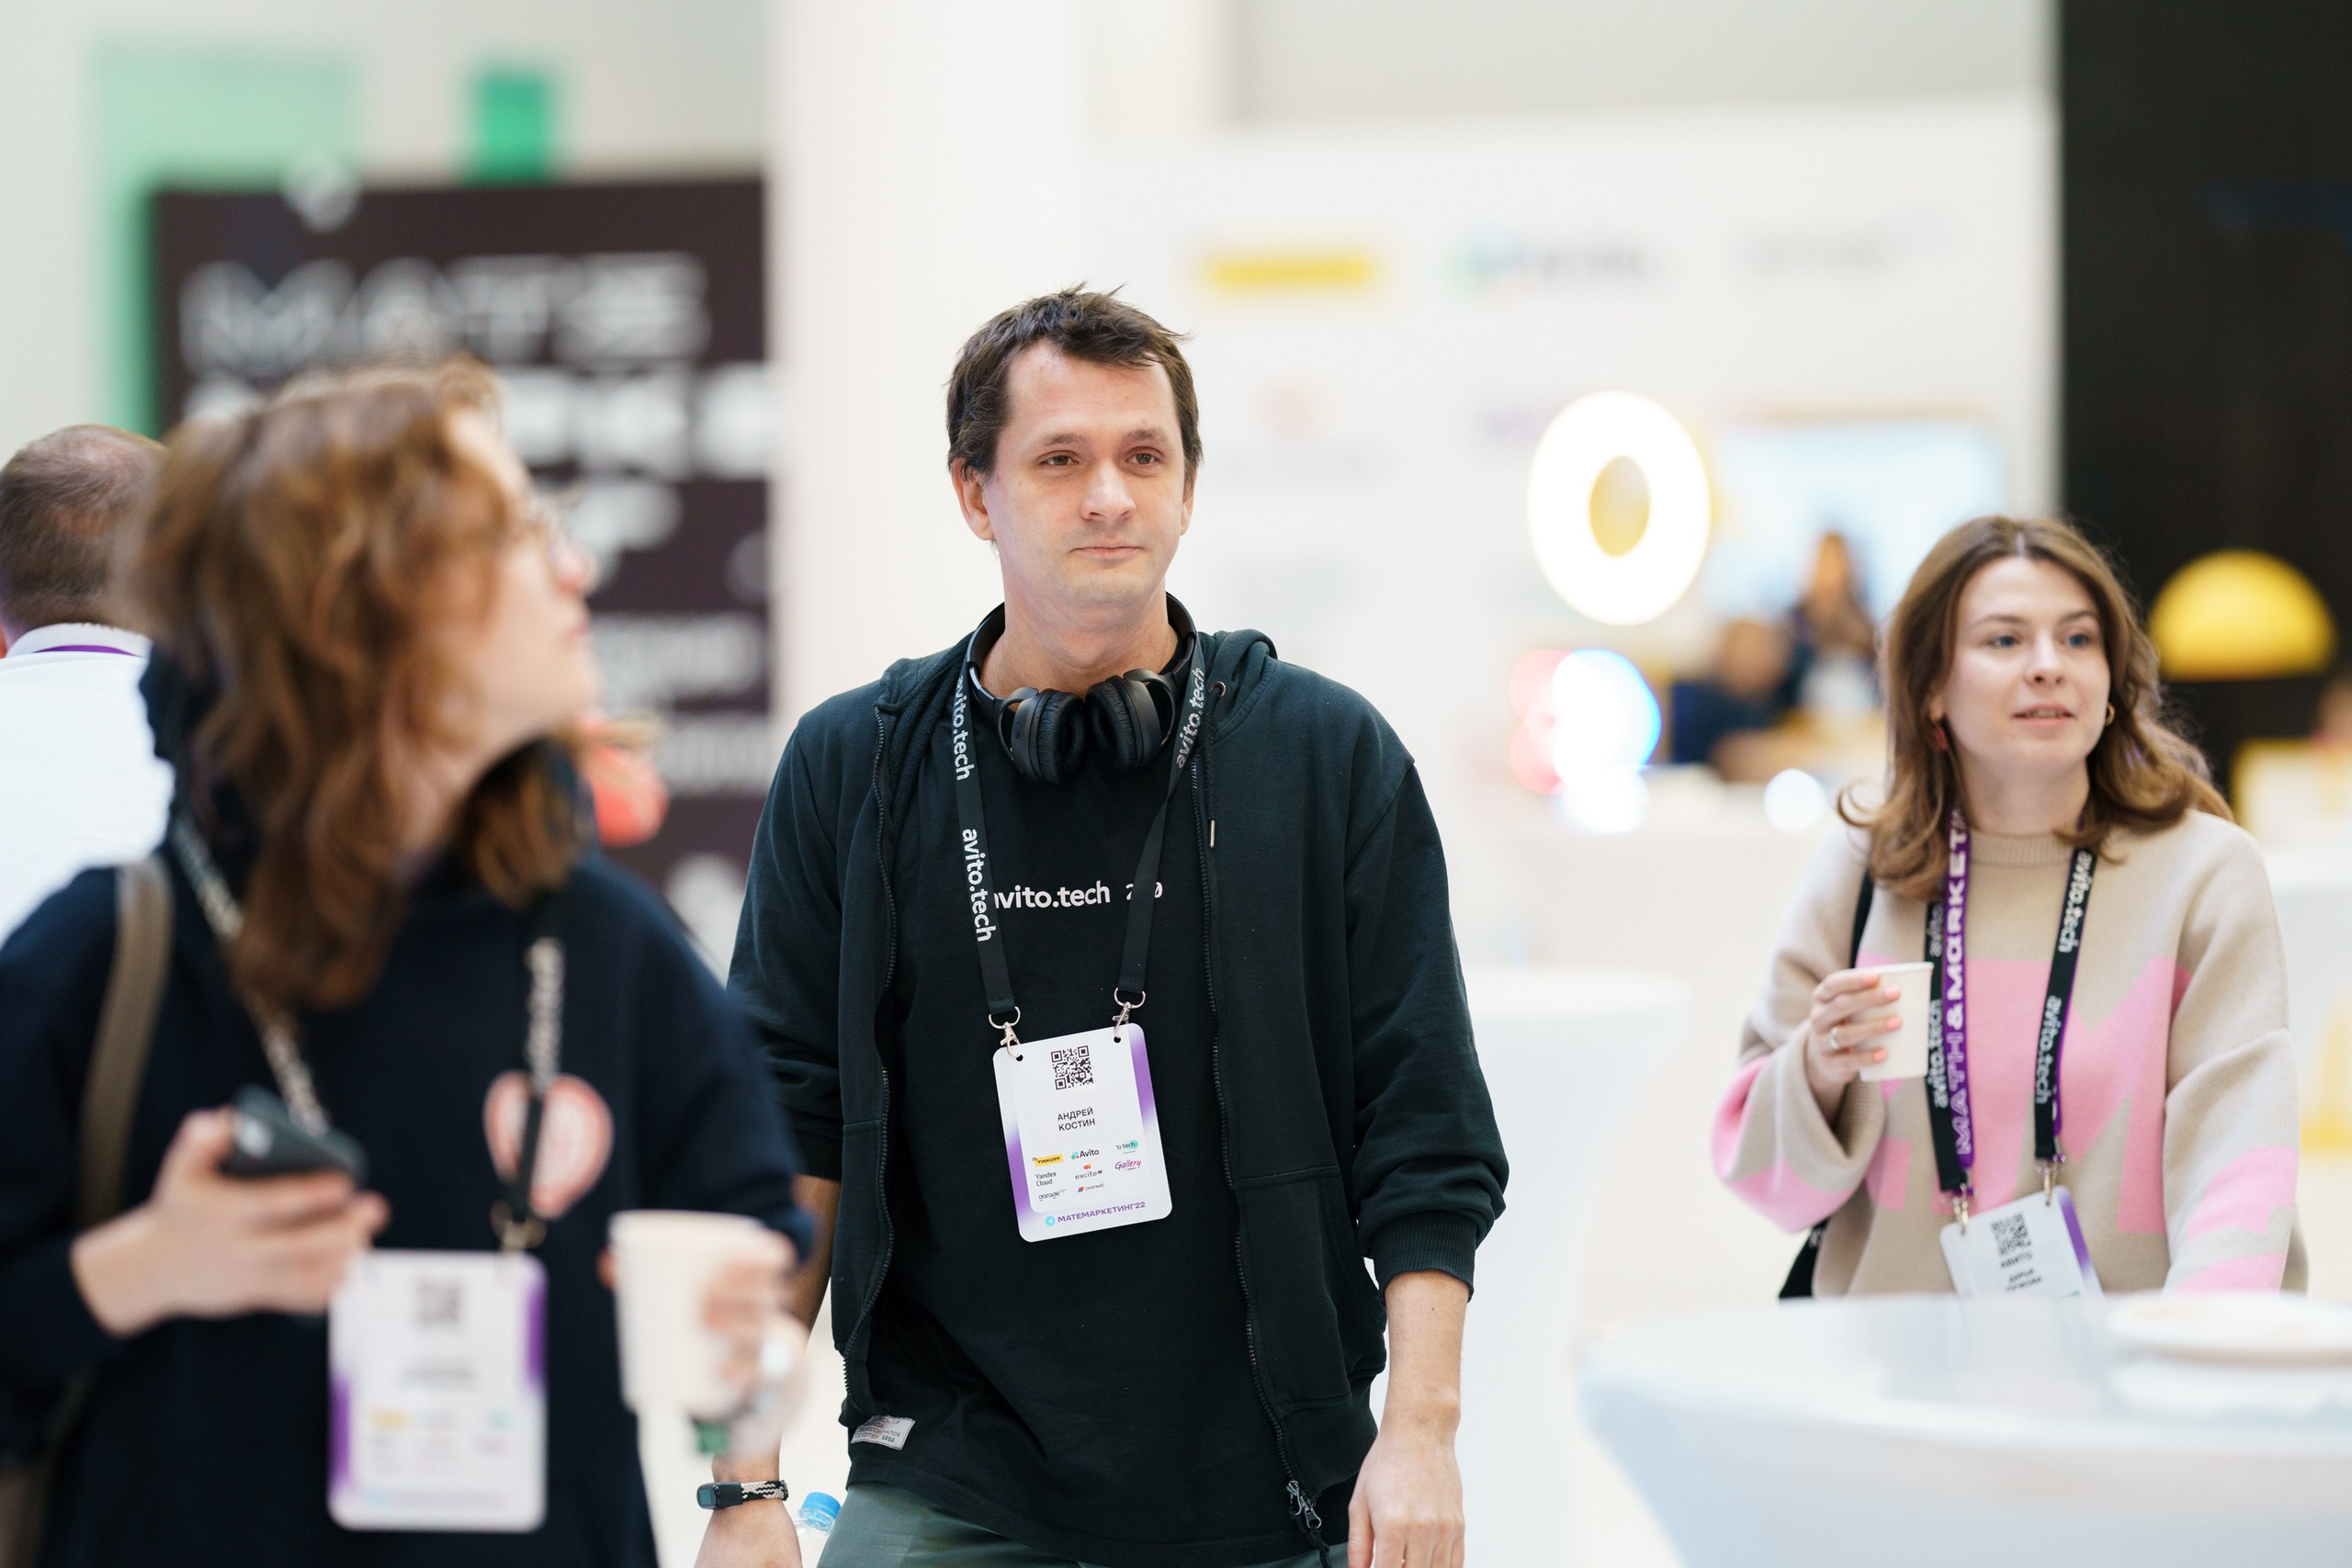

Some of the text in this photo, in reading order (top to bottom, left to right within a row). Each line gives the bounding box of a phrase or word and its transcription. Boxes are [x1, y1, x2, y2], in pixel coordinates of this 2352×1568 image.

[1176, 667, 1205, 769] avito.tech
[953, 675, 975, 781] avito.tech
[962, 829, 996, 942] avito.tech
[2057, 850, 2093, 953] avito.tech
[2035, 994, 2063, 1104] avito.tech
[1057, 1107, 1093, 1122] АНДРЕЙ
[1058, 1119, 1096, 1132] КОСТИН
[1037, 1156, 1060, 1165] TINKOFF
[1080, 1148, 1100, 1158] Avito
[1114, 1159, 1142, 1170] Gallery
[1035, 1171, 1057, 1180] Yandex
[1035, 1179, 1053, 1187] Cloud
[1057, 1201, 1147, 1224] МАТЕМАРКЕТИНГ22
